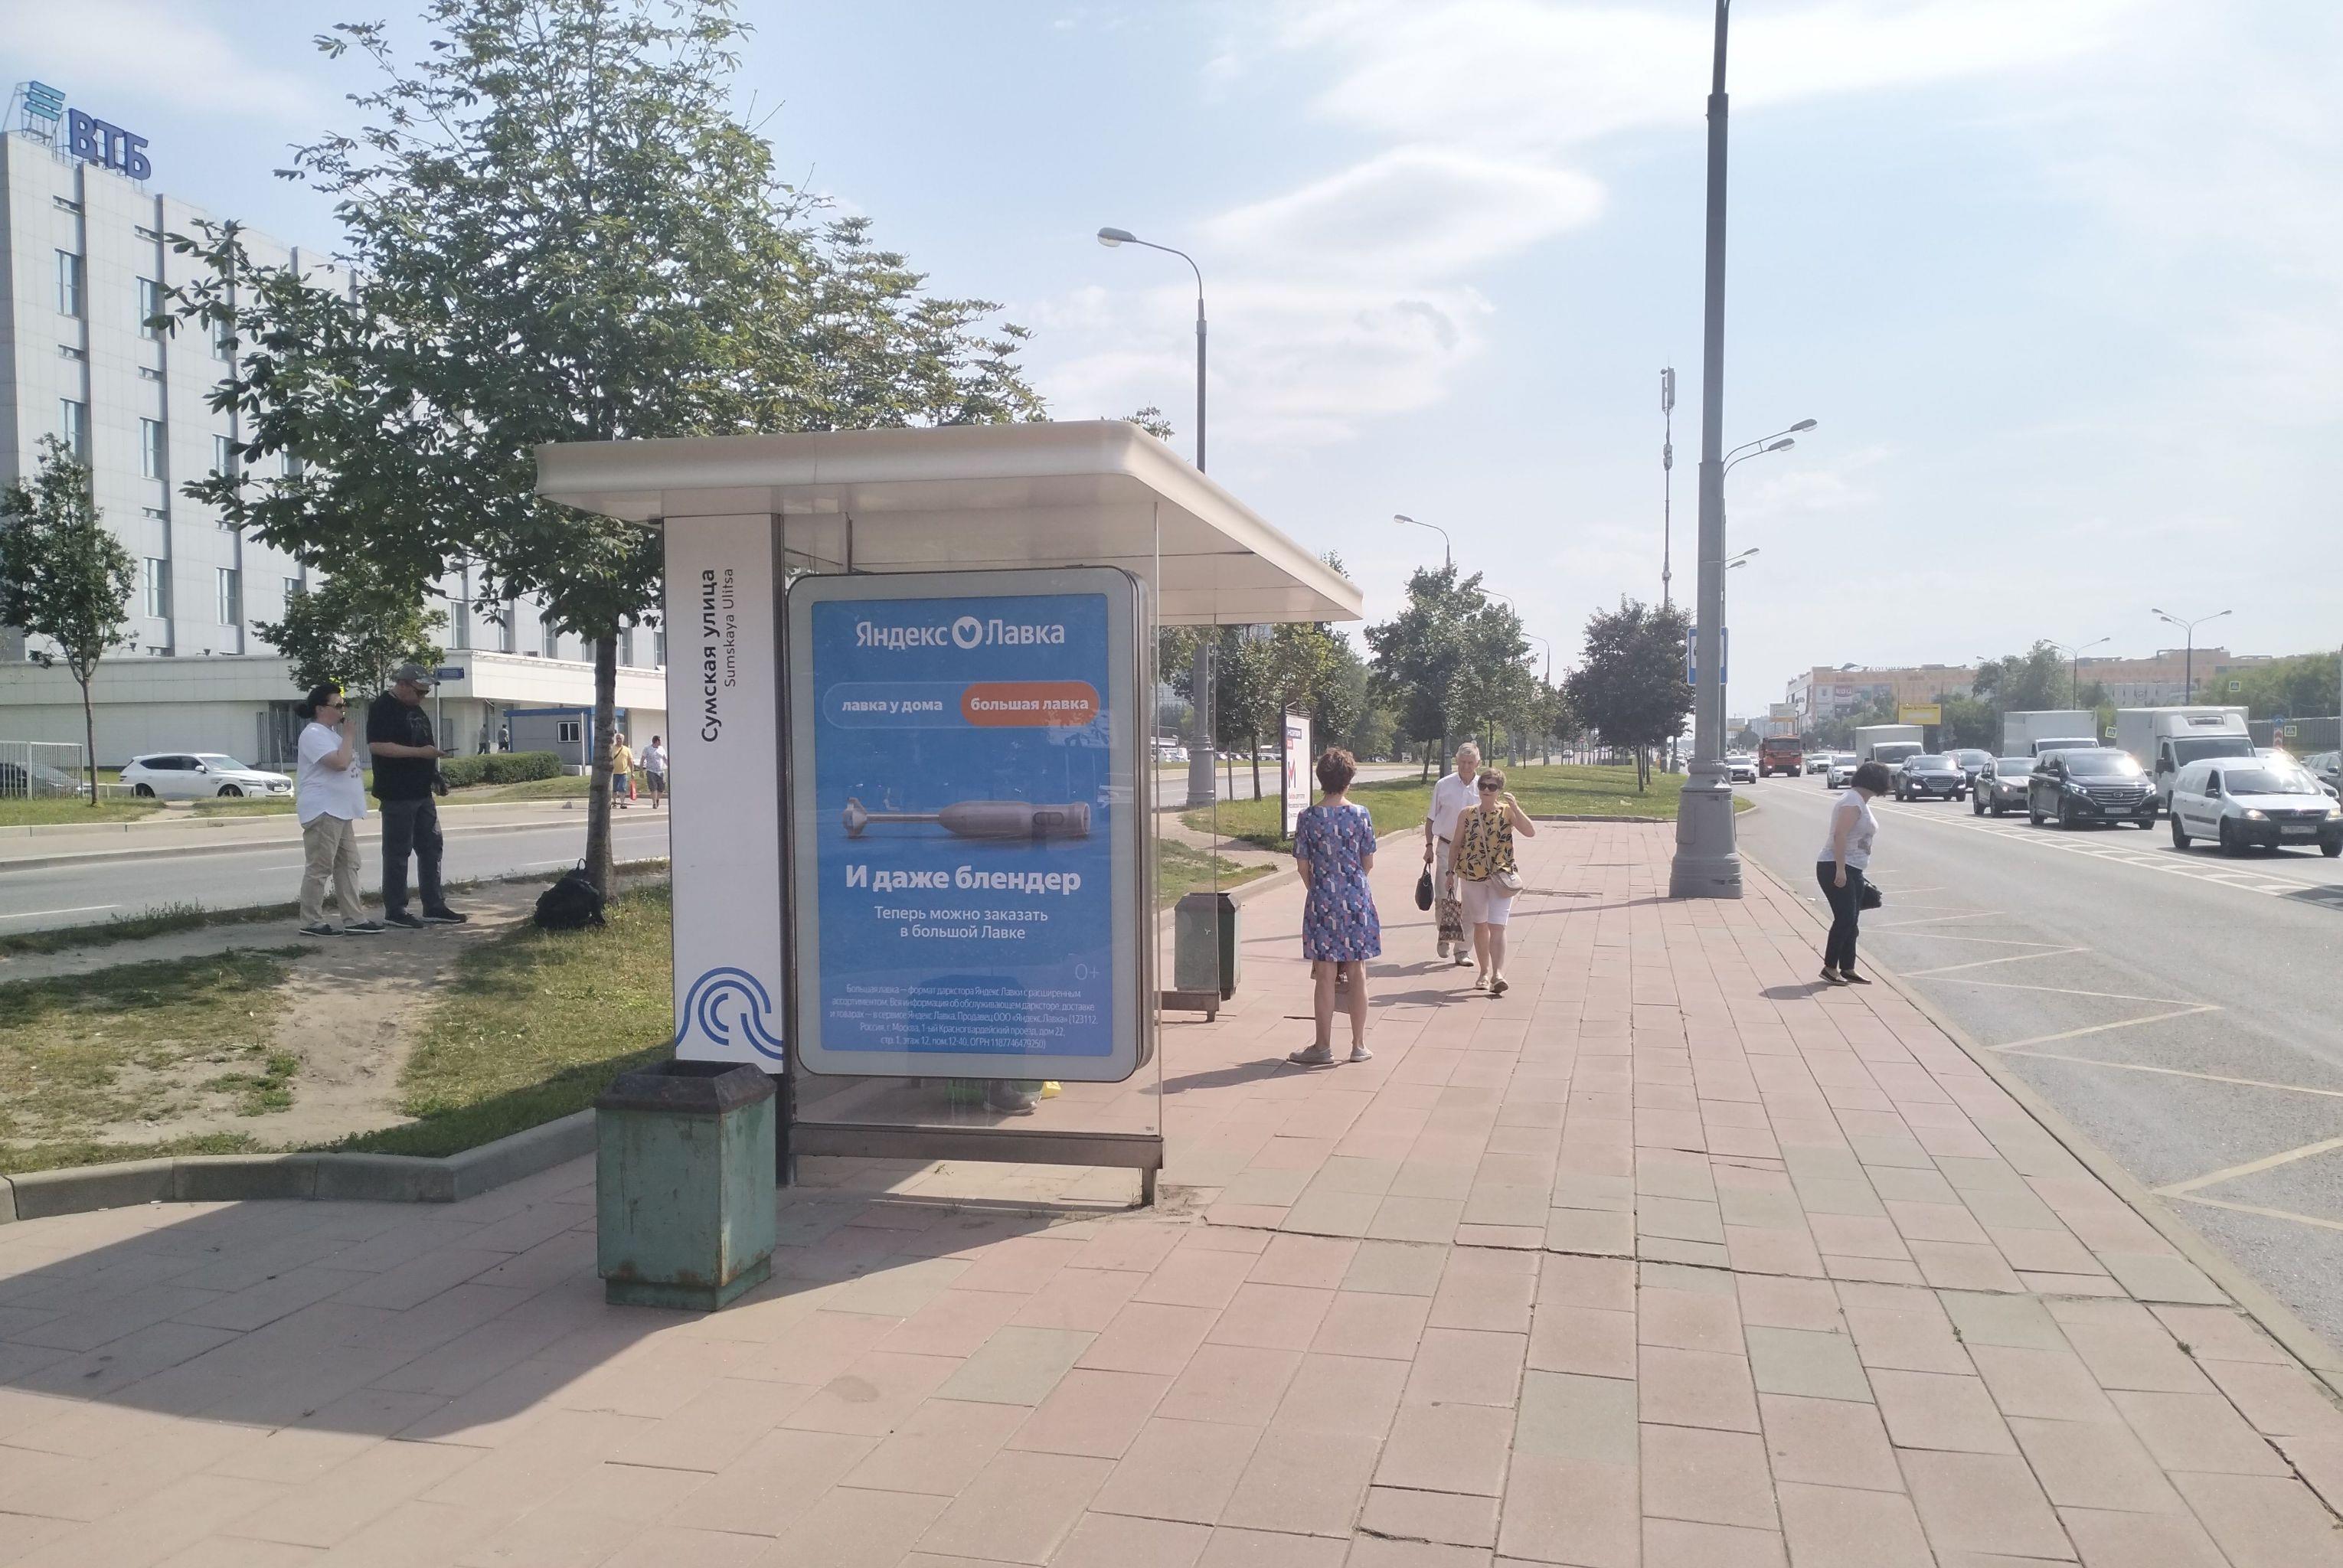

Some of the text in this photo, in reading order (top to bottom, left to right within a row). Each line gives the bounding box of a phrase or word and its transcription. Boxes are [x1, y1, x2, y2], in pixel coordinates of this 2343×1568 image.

[69, 108, 152, 180] ВТБ
[722, 569, 737, 688] Sumskaya Ulitsa
[856, 619, 1065, 650] Яндекс Лавка
[701, 570, 722, 742] Сумская улица
[842, 700, 943, 714] лавка у дома
[970, 697, 1089, 711] большая лавка
[845, 864, 1081, 895] И даже блендер
[874, 906, 1048, 923] Теперь можно заказать
[900, 924, 1025, 939] в большой Лавке
